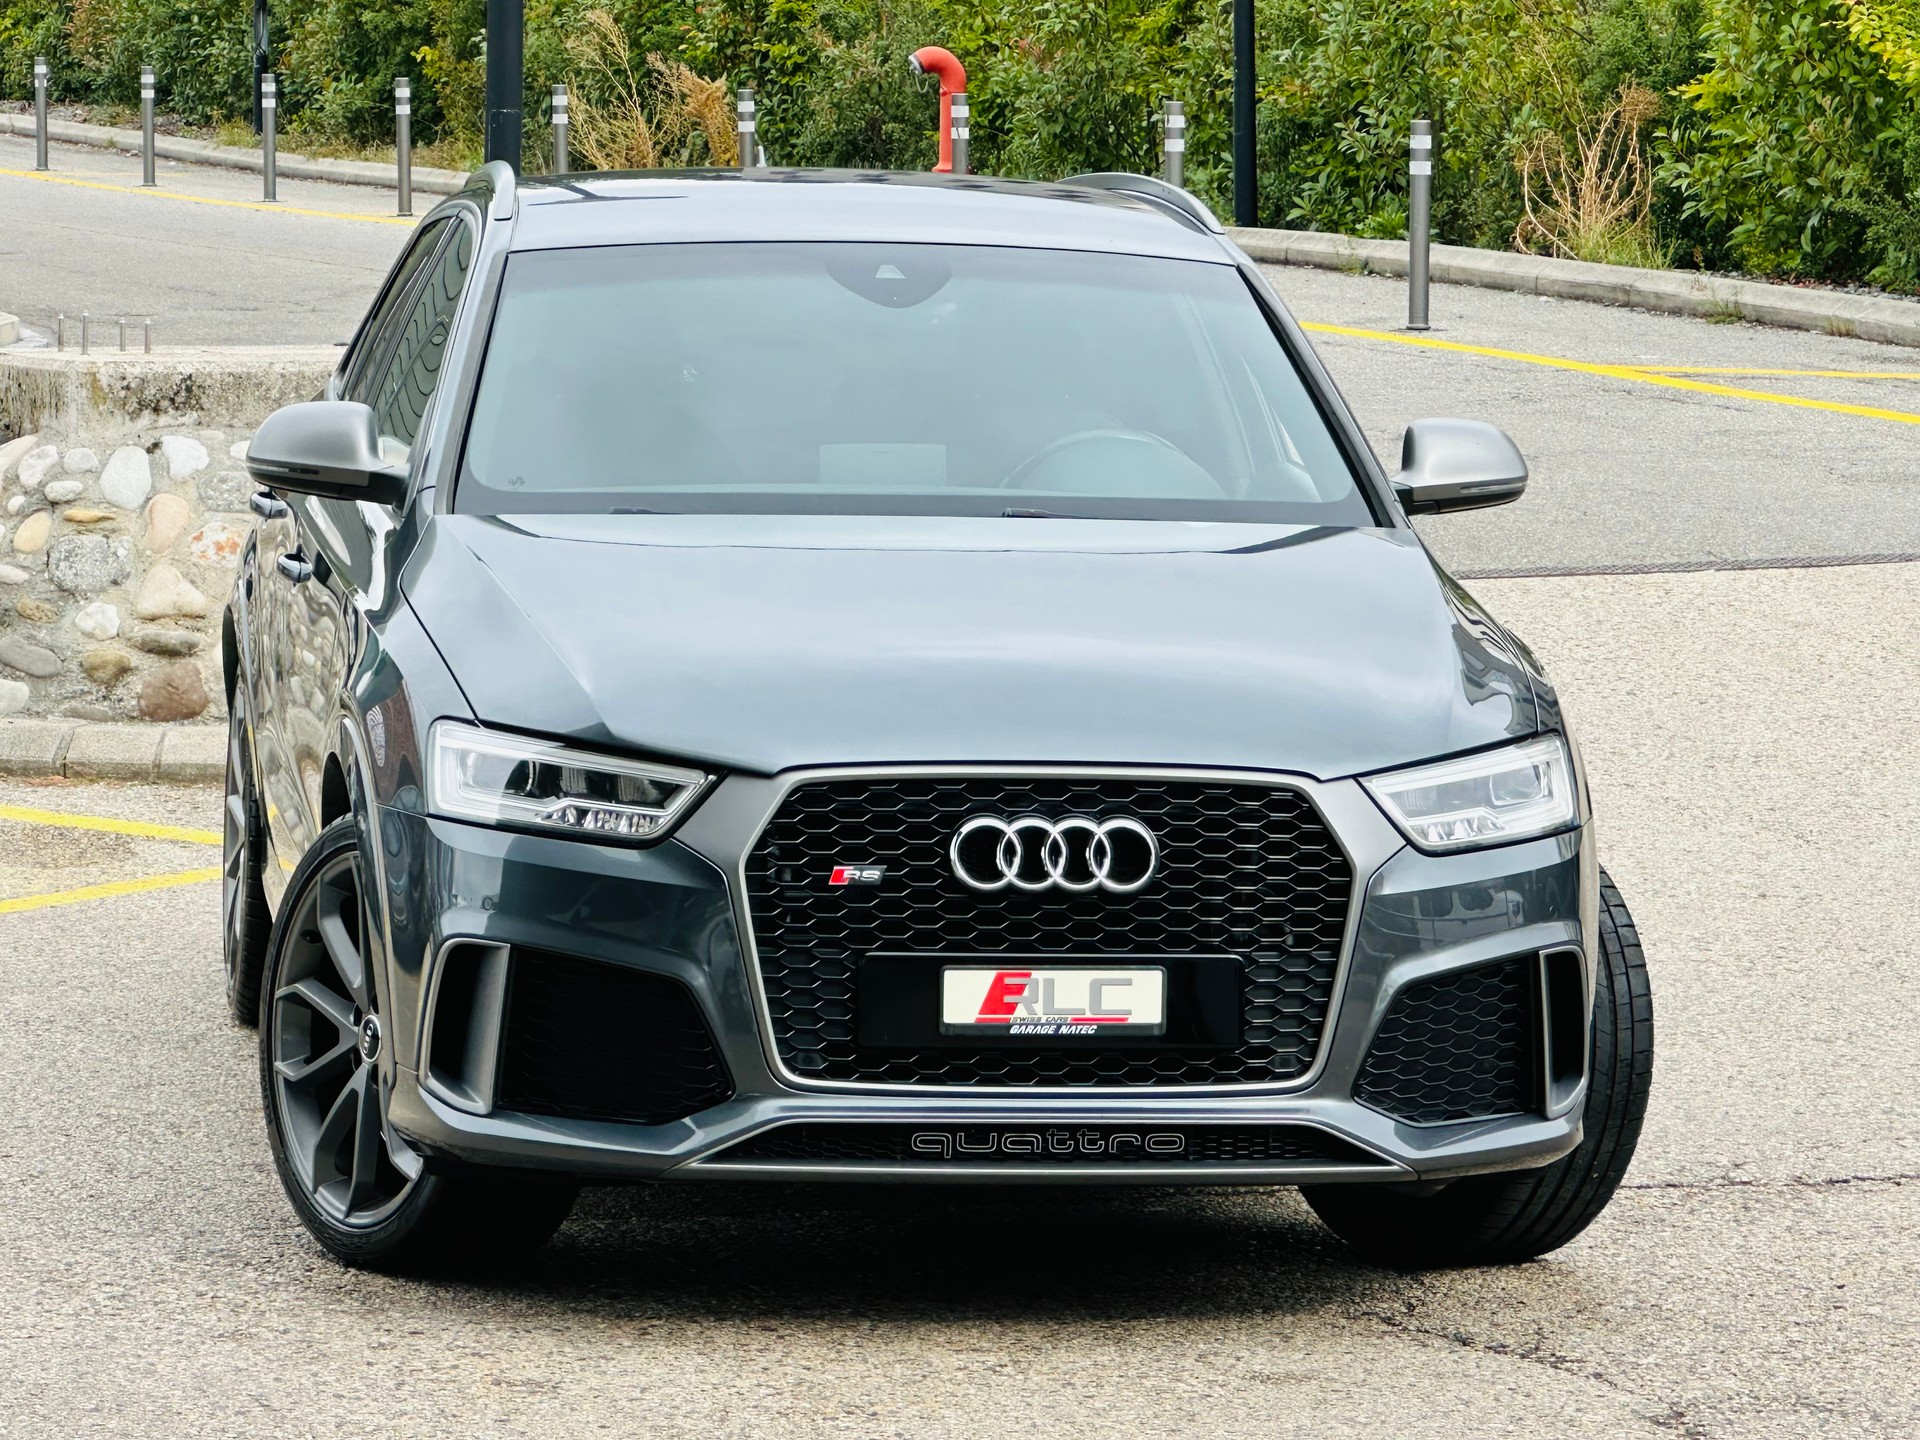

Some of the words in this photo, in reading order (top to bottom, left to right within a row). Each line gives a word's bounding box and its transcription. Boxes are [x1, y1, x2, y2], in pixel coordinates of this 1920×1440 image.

[842, 869, 881, 881] RS
[1011, 1016, 1042, 1024] SWISS
[1045, 1016, 1070, 1024] CARS
[1009, 1024, 1058, 1035] GARAGE
[1058, 1024, 1098, 1035] NATEC
[911, 1128, 1186, 1159] quattro
